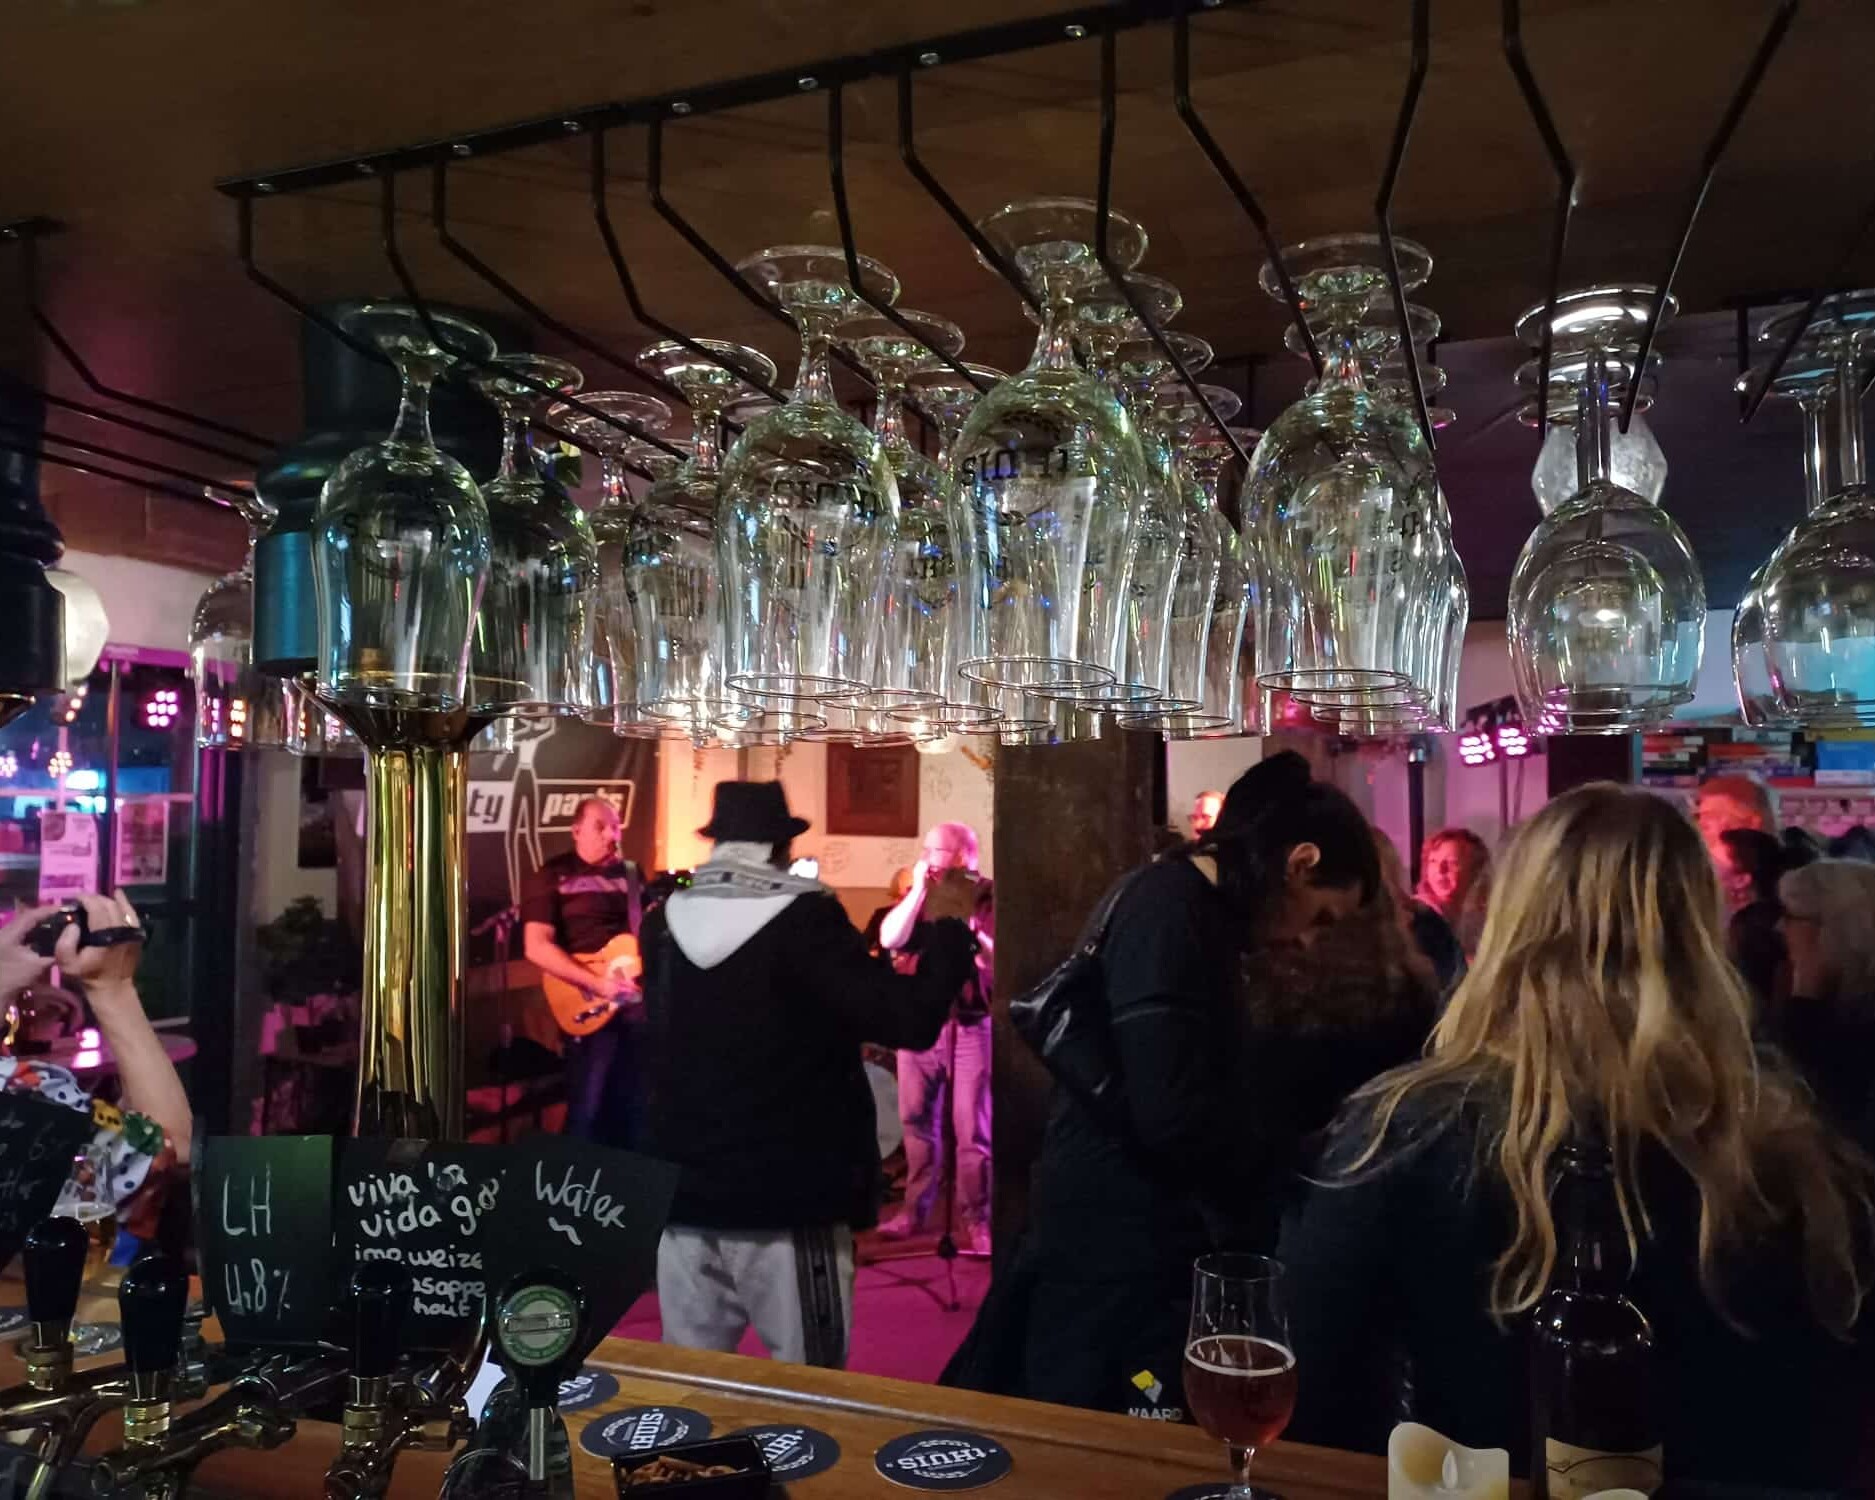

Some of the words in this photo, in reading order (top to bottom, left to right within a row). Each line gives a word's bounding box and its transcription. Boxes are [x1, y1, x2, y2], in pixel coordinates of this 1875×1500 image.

[223, 1162, 271, 1236] LH
[348, 1172, 420, 1207] viva
[360, 1195, 442, 1238] vida
[535, 1160, 626, 1228] Water
